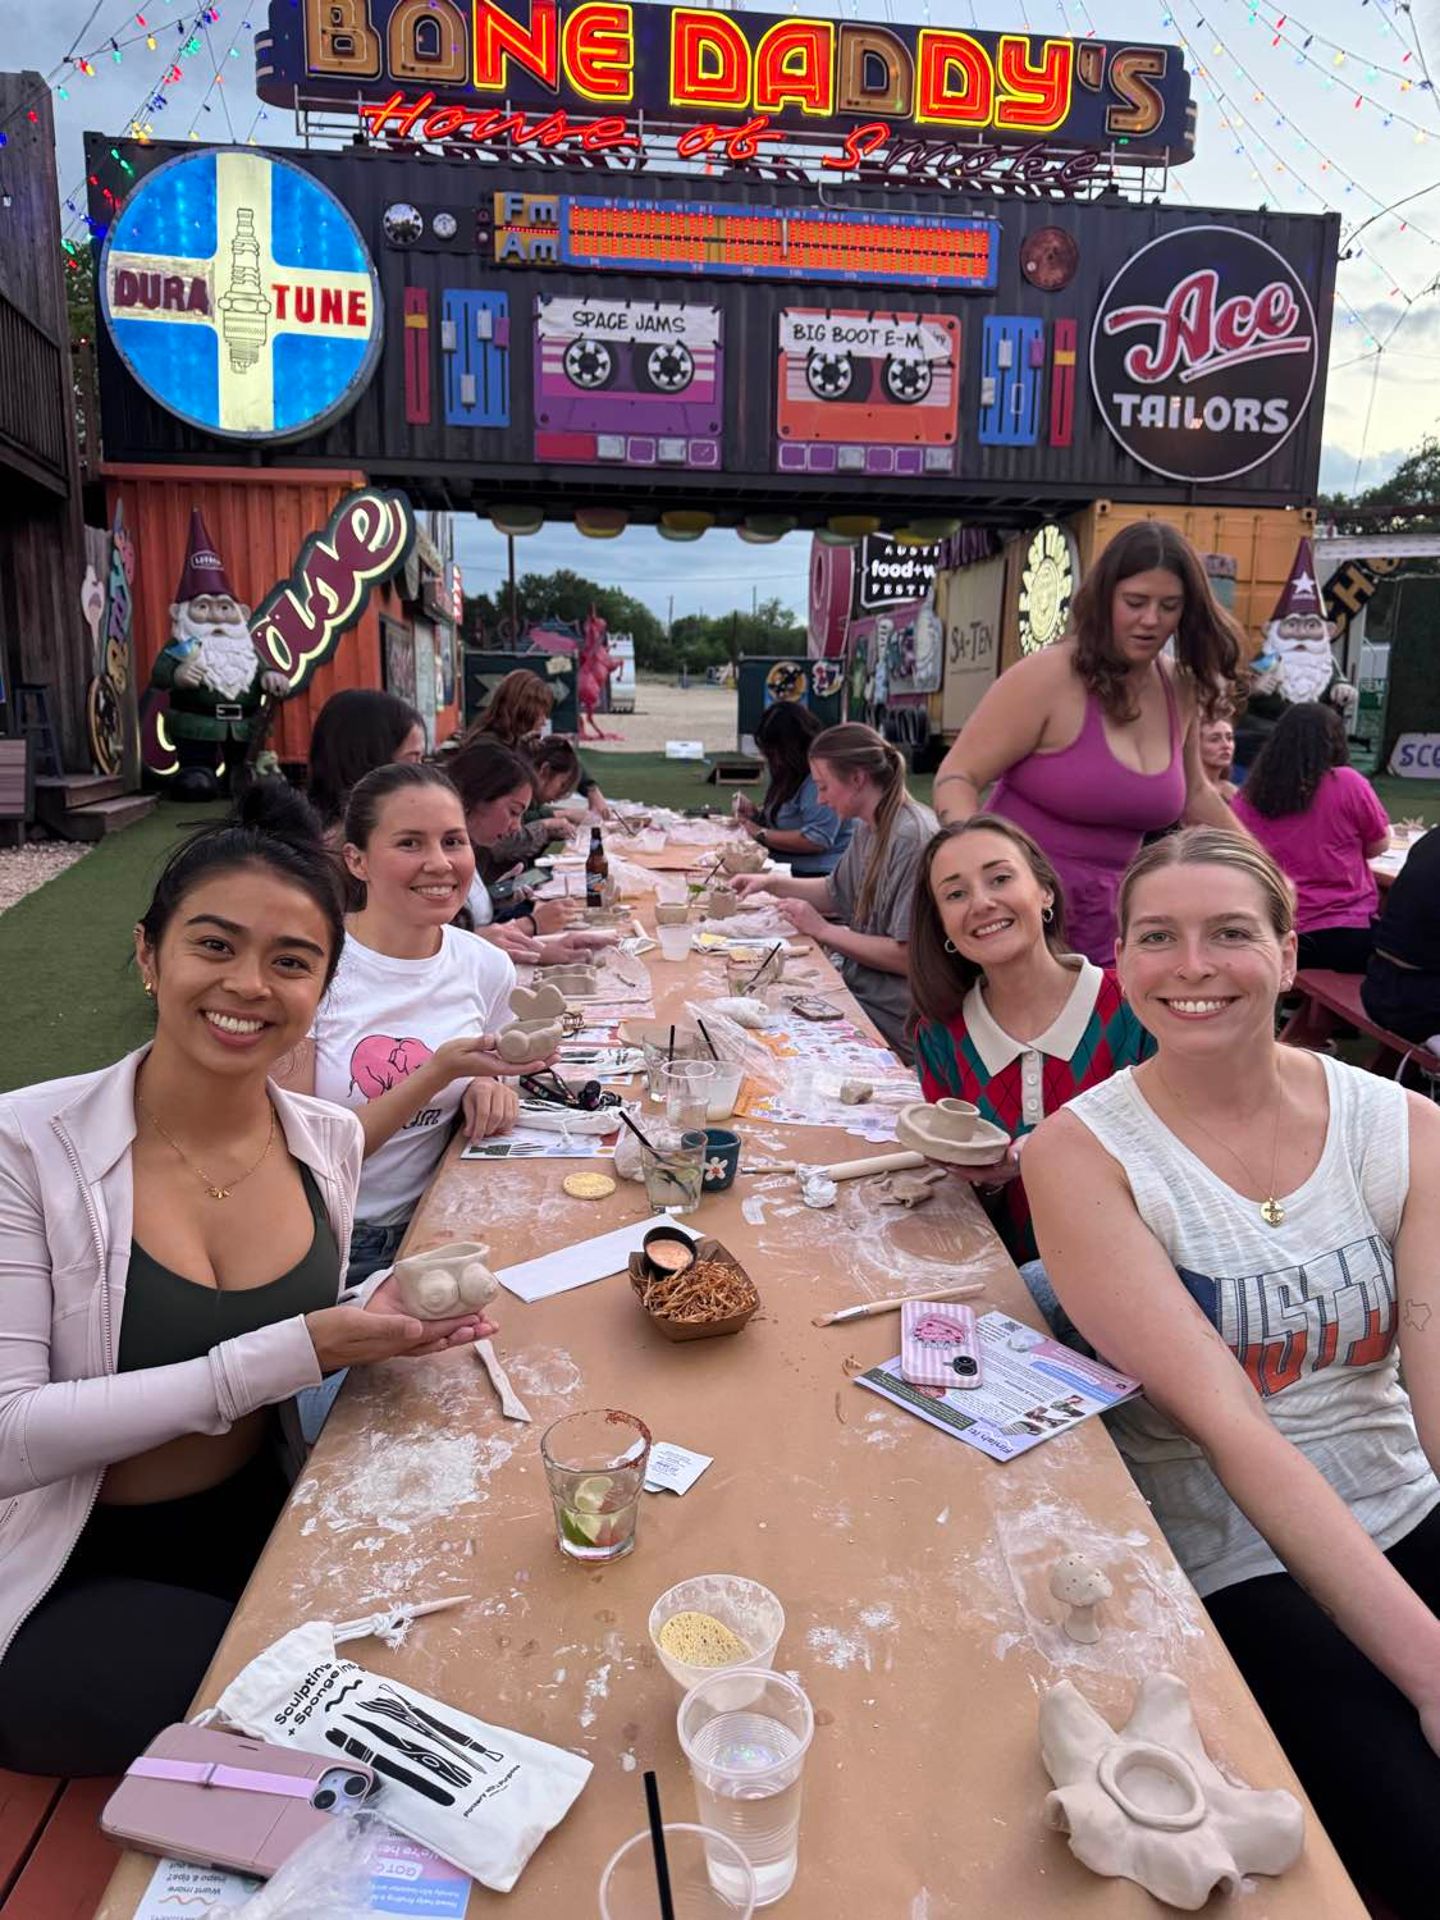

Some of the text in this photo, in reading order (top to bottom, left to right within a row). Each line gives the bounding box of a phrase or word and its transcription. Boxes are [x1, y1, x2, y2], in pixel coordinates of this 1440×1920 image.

[303, 0, 1168, 136] BONE DADDY'S
[361, 91, 1112, 187] House of Smoke
[503, 196, 560, 224] Fm
[502, 232, 560, 262] Am
[113, 268, 367, 327] DURA TUNE
[572, 310, 687, 333] SPACE JAMS
[793, 324, 827, 342] BIG
[832, 326, 881, 345] BOOT
[1103, 268, 1300, 384] Ace
[1112, 392, 1290, 434] TAILORS
[294, 1670, 340, 1725] Sponge
